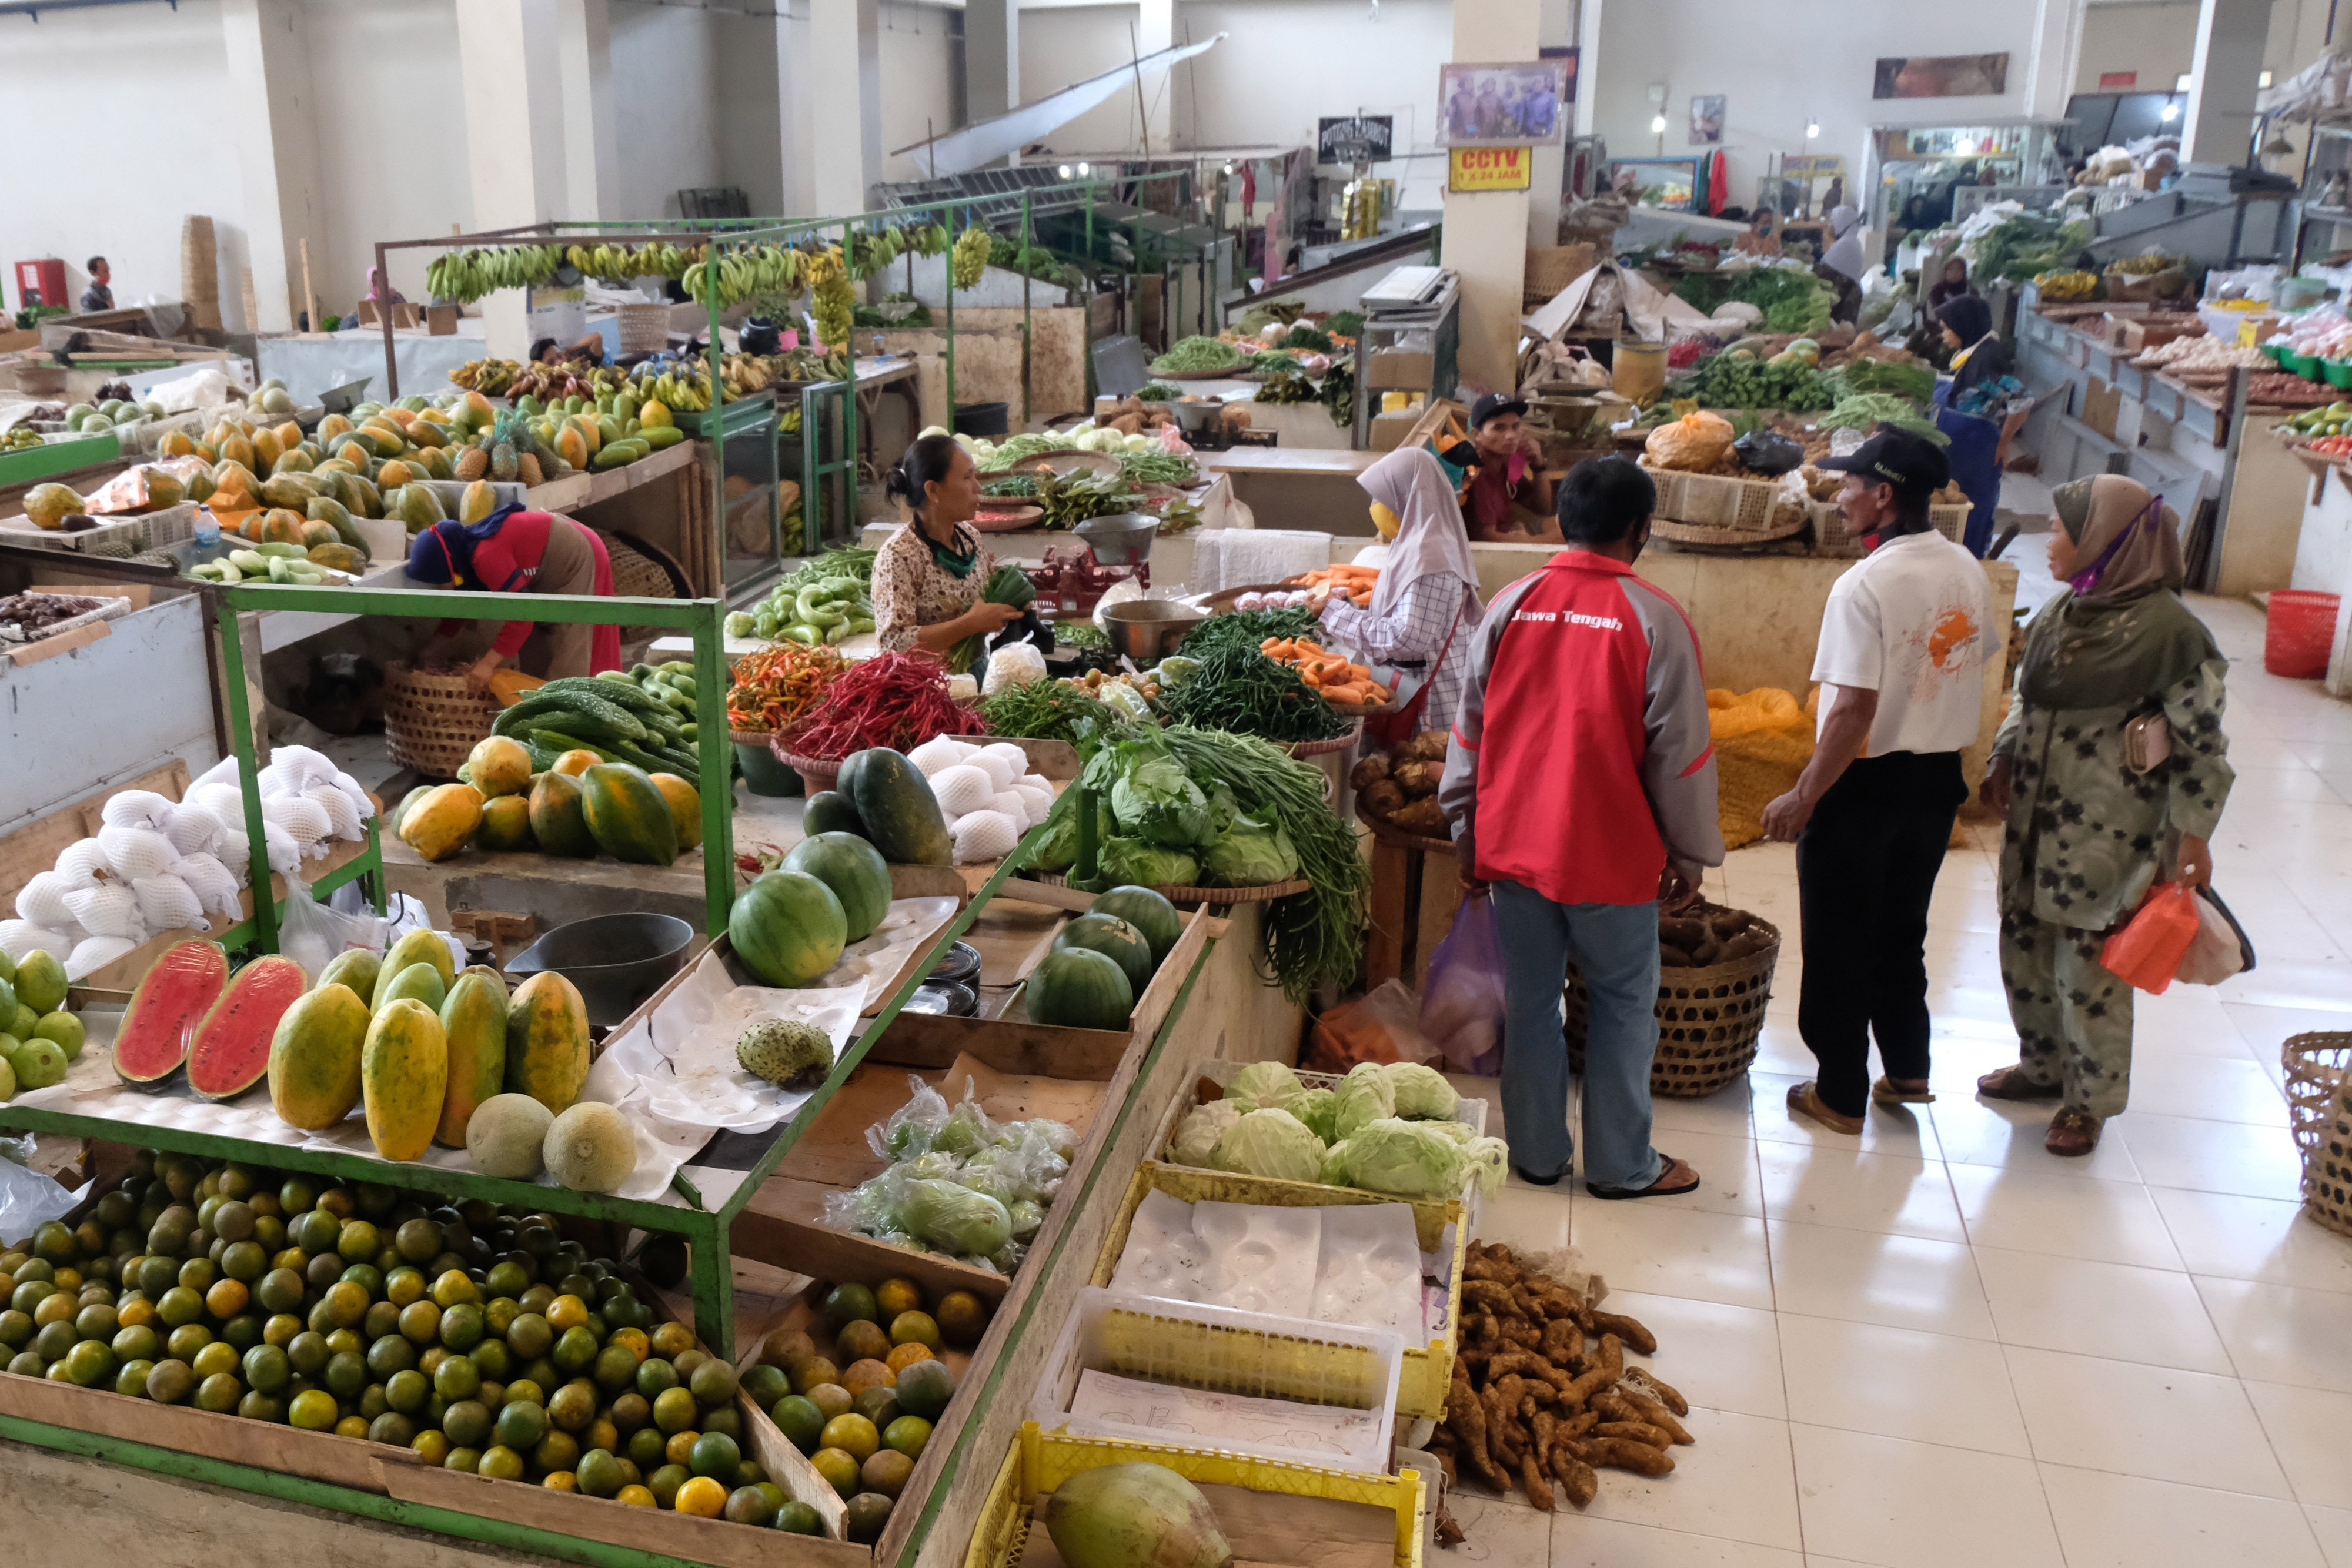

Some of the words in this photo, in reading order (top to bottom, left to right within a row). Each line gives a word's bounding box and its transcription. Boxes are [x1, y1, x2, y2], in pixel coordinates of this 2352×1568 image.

[1462, 149, 1520, 169] CCTV
[1481, 171, 1493, 180] 24
[1498, 170, 1521, 179] JAM
[1511, 609, 1556, 622] Jawa
[1562, 610, 1623, 631] Tengah
